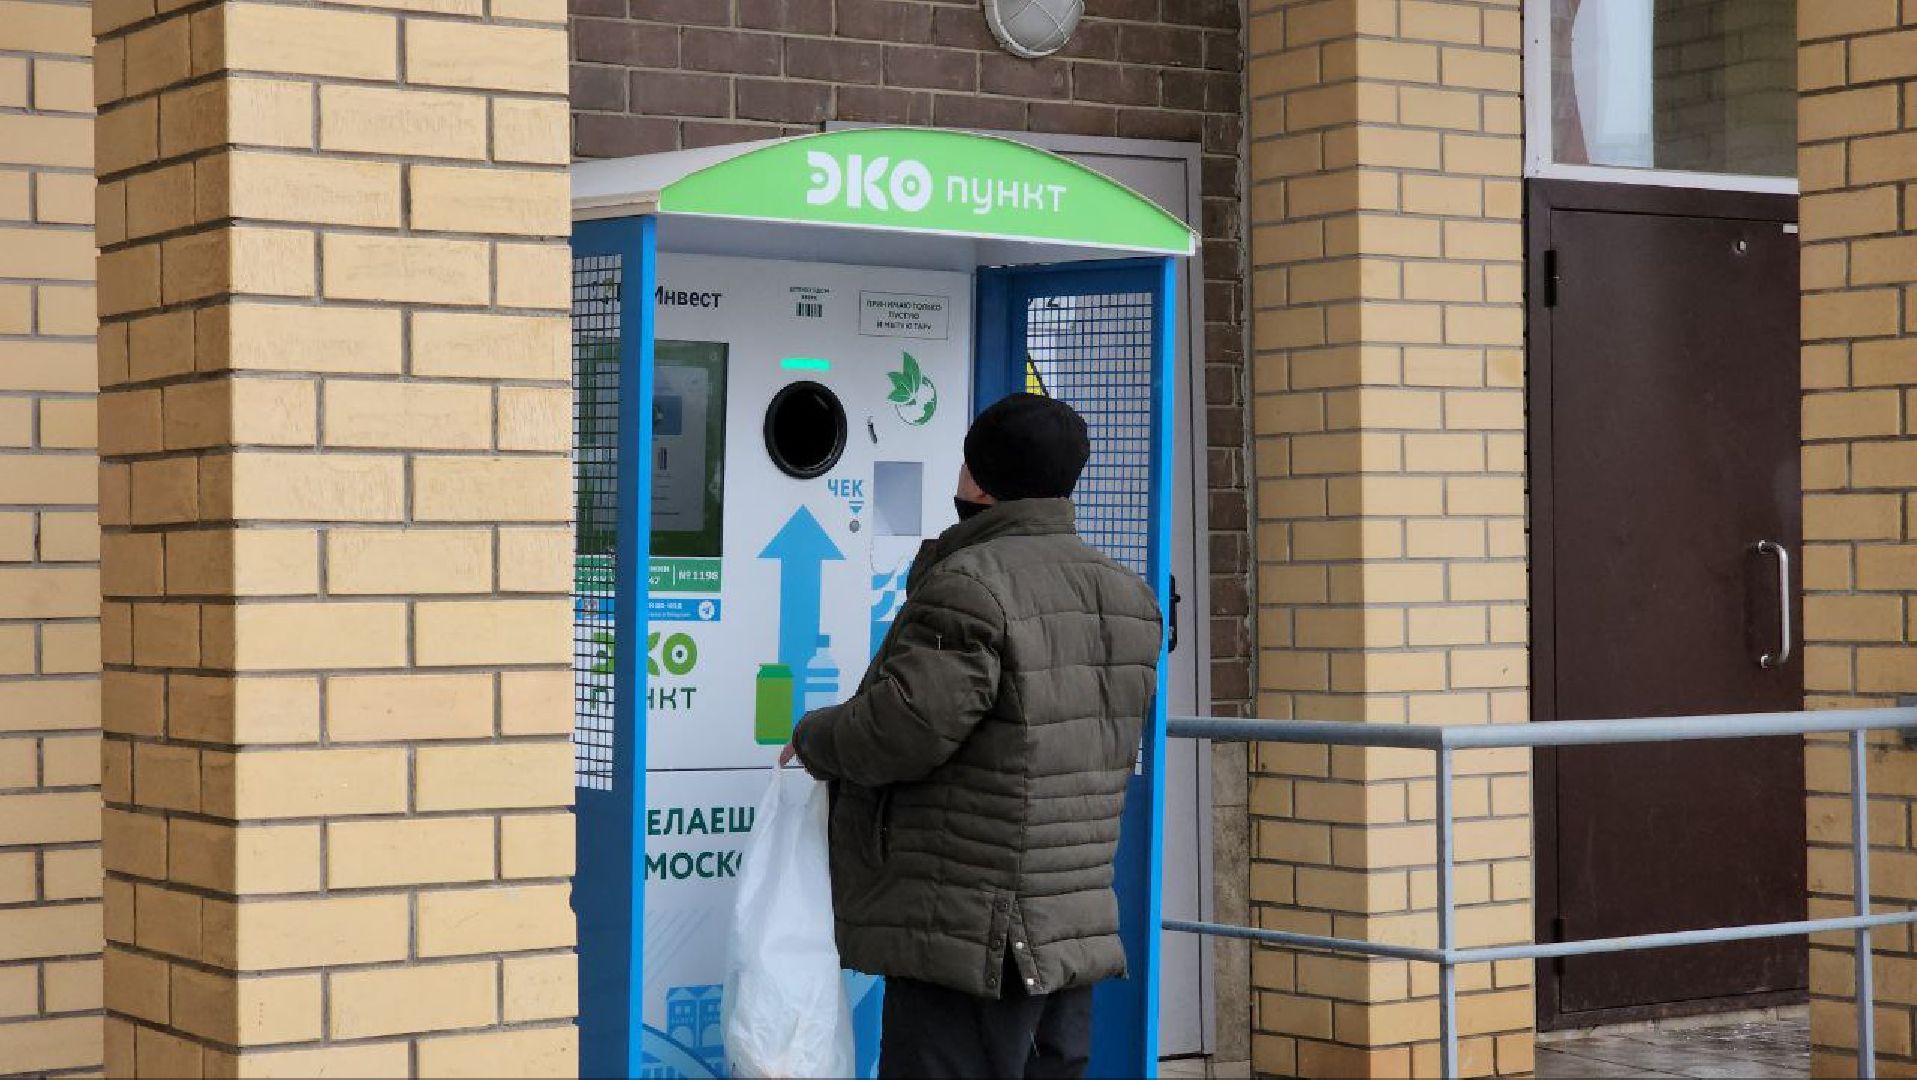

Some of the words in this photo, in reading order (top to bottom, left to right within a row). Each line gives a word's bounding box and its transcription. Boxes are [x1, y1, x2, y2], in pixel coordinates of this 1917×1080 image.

[806, 151, 933, 212] ЭКО
[827, 479, 864, 497] ЧЕК
[644, 850, 743, 880] МОСК
